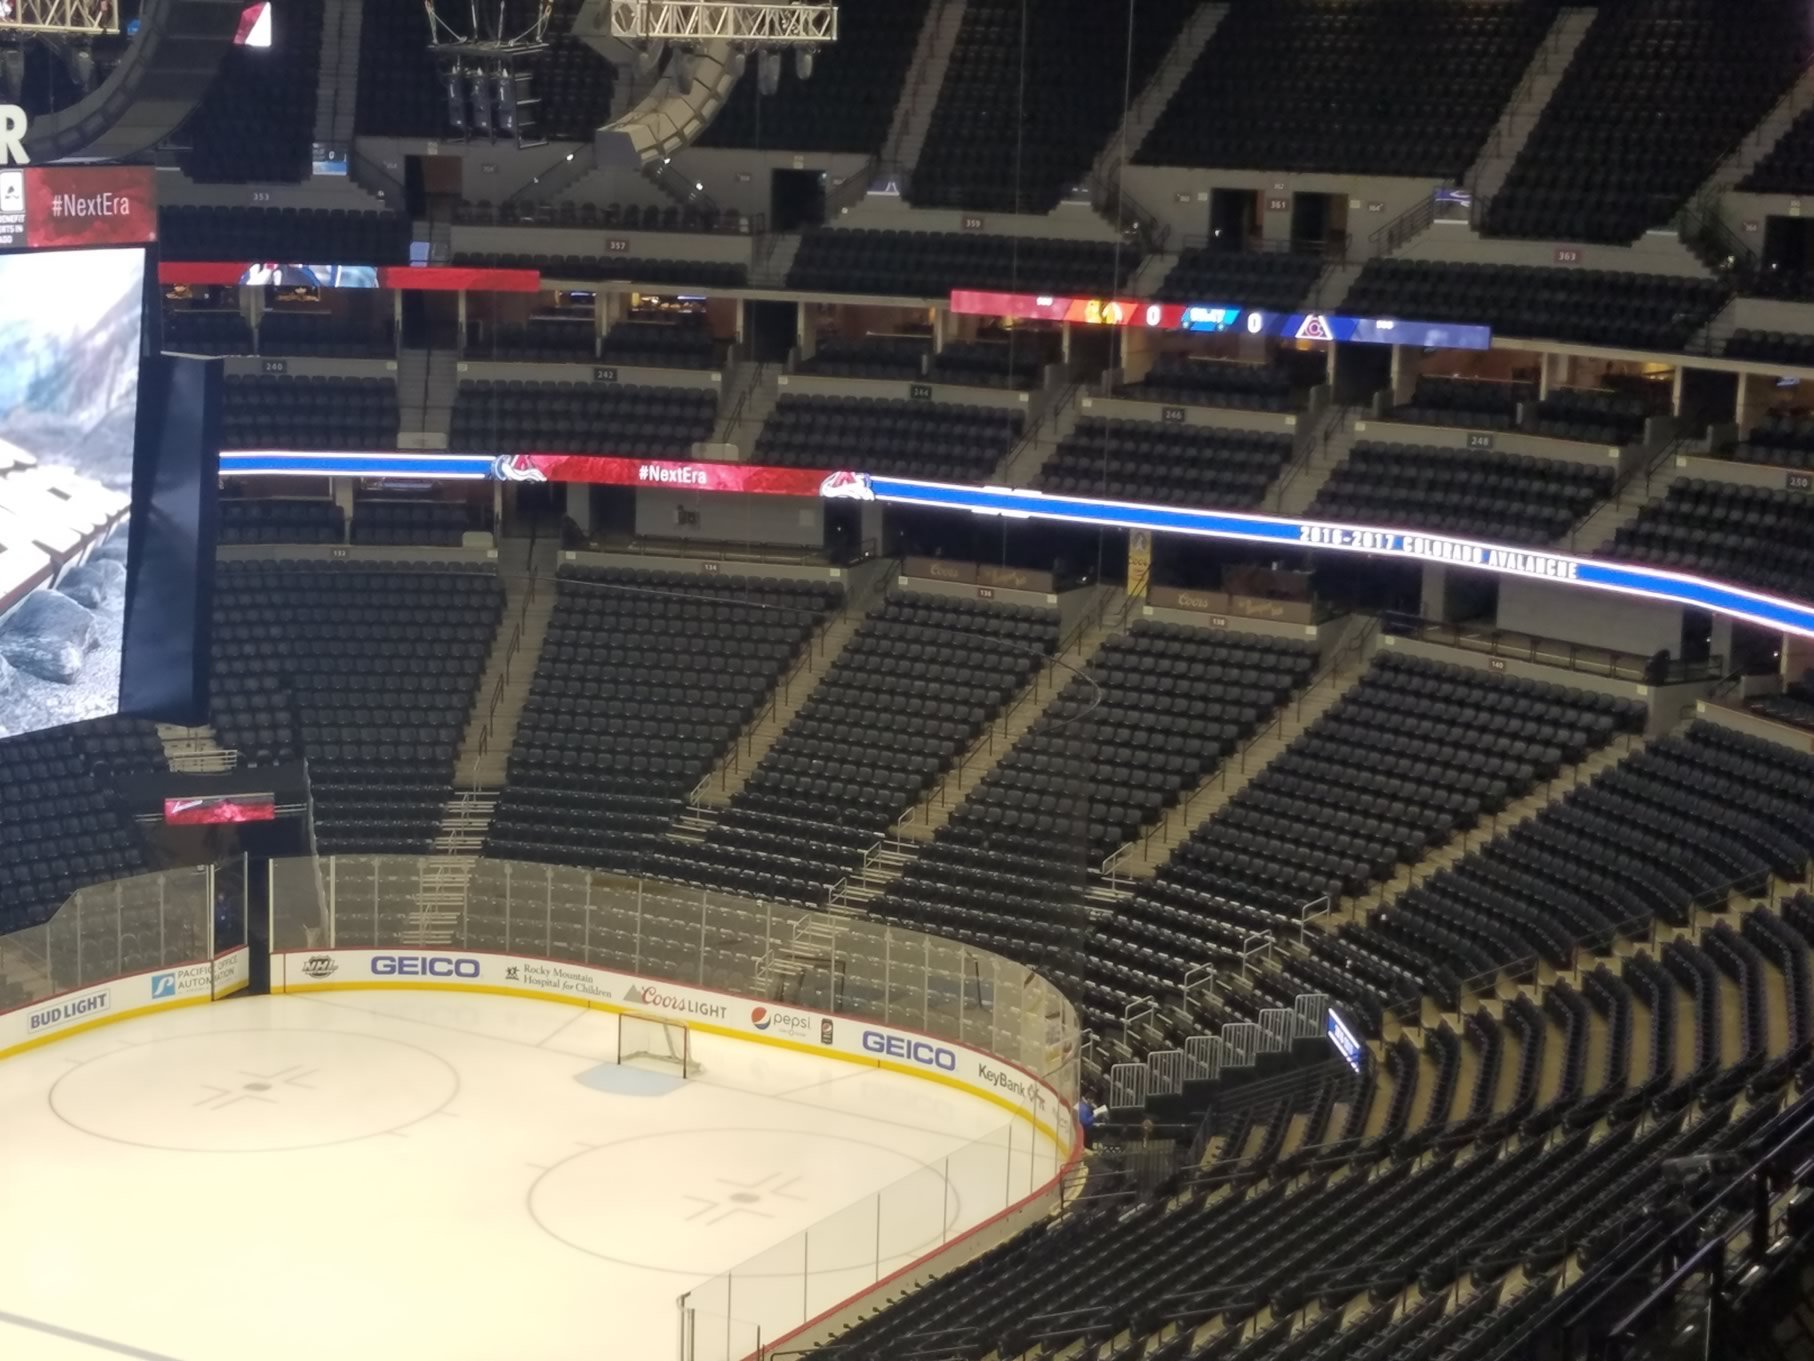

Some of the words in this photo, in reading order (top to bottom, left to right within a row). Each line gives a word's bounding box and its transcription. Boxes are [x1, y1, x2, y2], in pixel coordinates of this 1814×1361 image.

[52, 193, 130, 217] #NextEra
[610, 241, 626, 250] 357
[1559, 251, 1577, 261] 363
[1146, 305, 1161, 326] 0
[1247, 312, 1262, 333] 0
[266, 362, 284, 371] 240
[597, 370, 614, 379] 242
[639, 464, 707, 485] #NextEra
[1300, 526, 1395, 551] 2016-2017
[1402, 536, 1483, 563] COLORADO
[1488, 549, 1578, 579] AVALANCHE
[178, 963, 216, 979] PACIFIC
[218, 955, 238, 970] OFFICE
[302, 960, 338, 976] NHL
[371, 956, 480, 978] GEICO
[523, 964, 550, 978] Rocky
[553, 967, 594, 983] Mountain
[523, 974, 560, 990] Hospital
[562, 980, 574, 991] for
[575, 982, 612, 999] Children
[30, 1008, 62, 1029] BUD
[63, 993, 107, 1018] LIGHT
[642, 985, 686, 1011] Coors
[688, 1003, 727, 1019] LIGHT
[773, 1013, 811, 1030] pepsi
[862, 1030, 956, 1072] GEICO
[978, 1063, 1025, 1097] KeyBank
